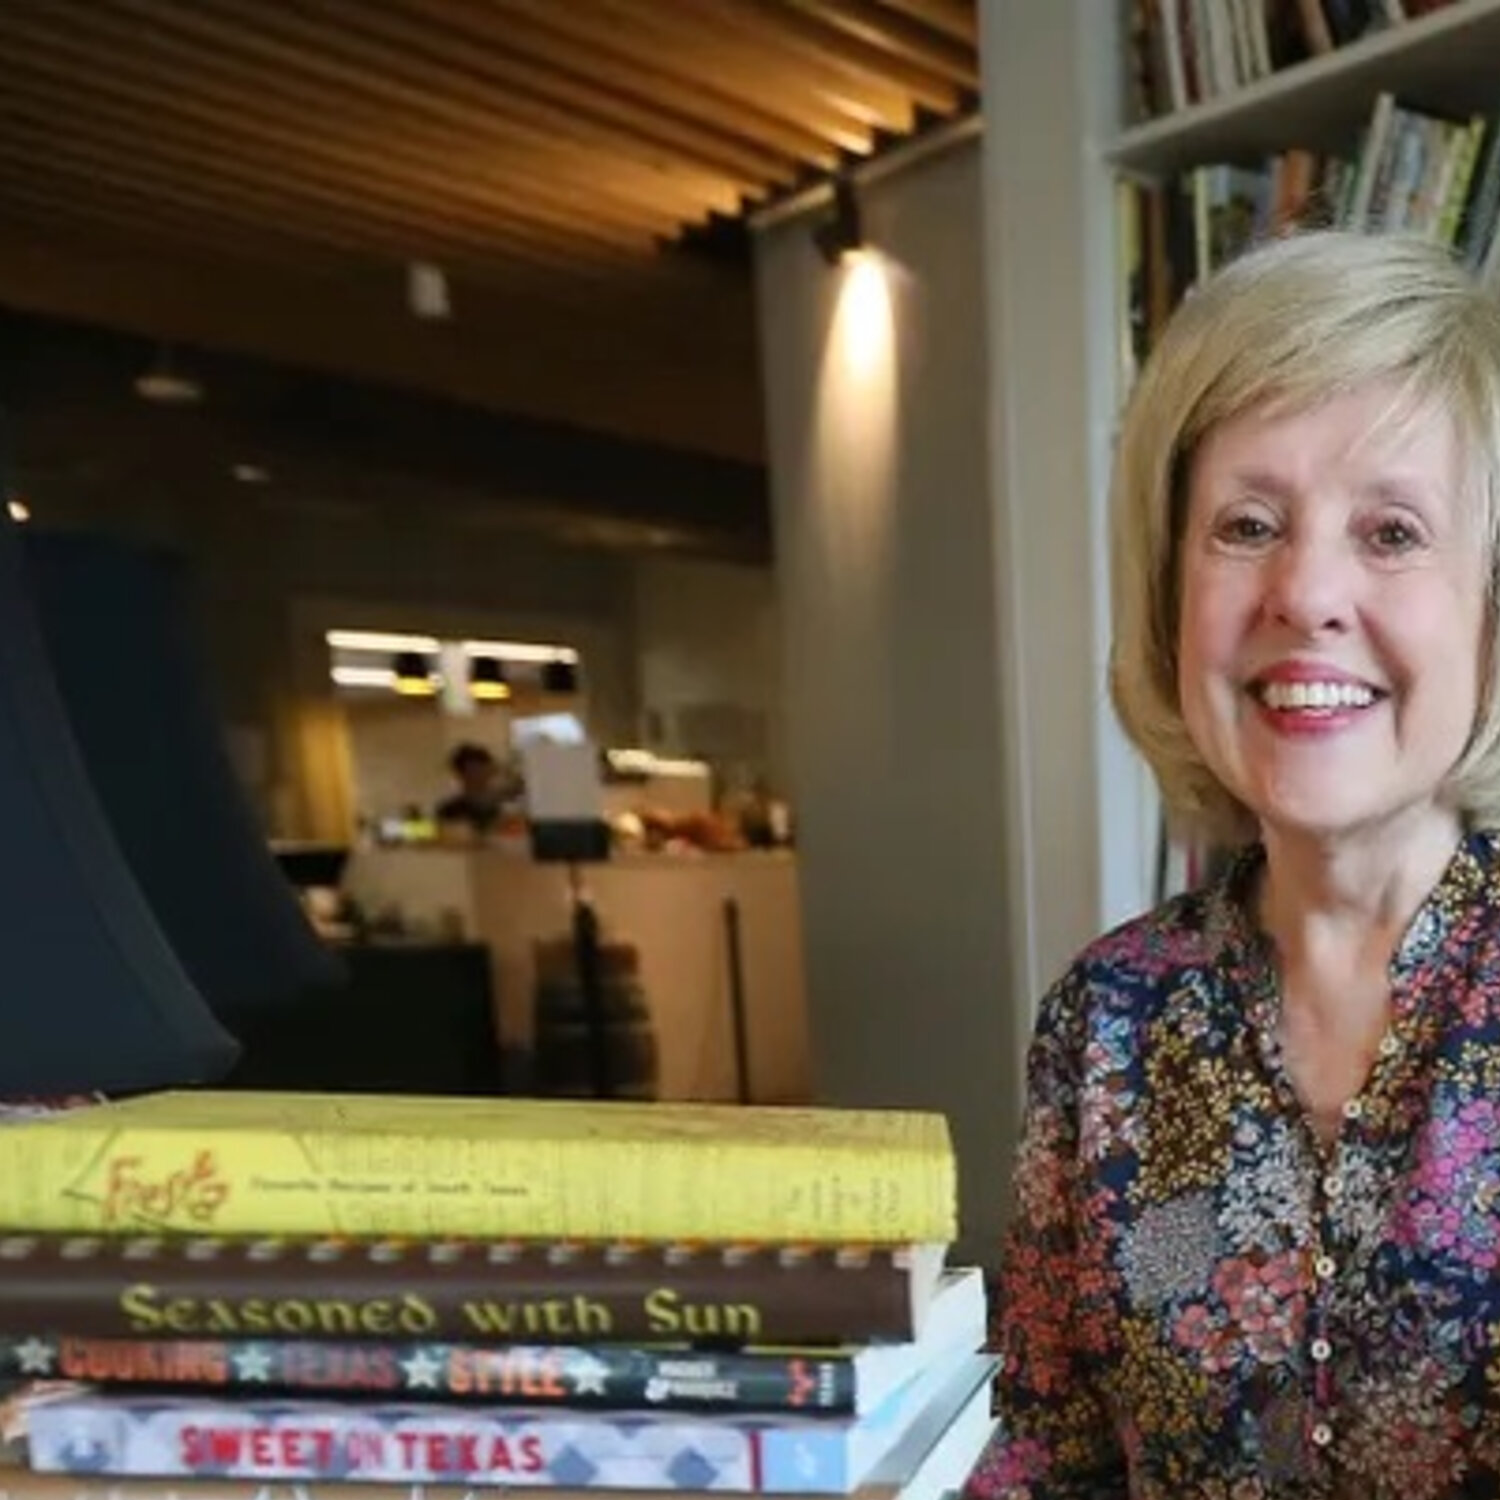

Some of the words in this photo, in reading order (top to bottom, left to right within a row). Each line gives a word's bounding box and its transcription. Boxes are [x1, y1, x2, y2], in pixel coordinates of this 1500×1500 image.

[121, 1284, 437, 1335] Seasoned
[462, 1296, 611, 1335] with
[644, 1288, 763, 1335] Sun
[180, 1426, 333, 1468] SWEET
[395, 1434, 545, 1475] TEXAS
